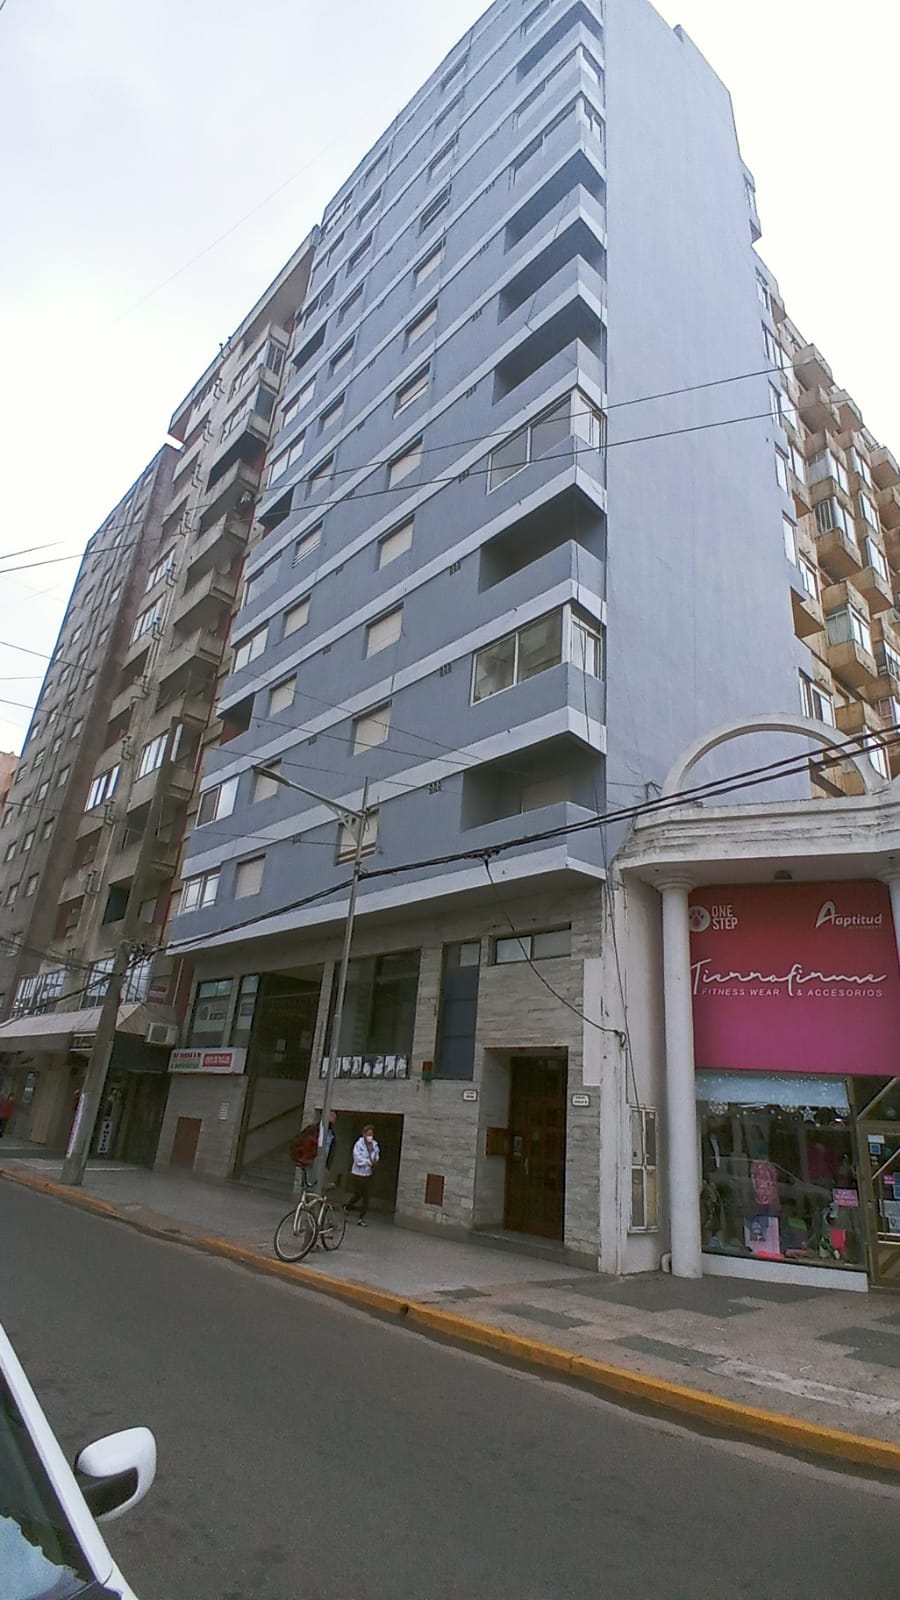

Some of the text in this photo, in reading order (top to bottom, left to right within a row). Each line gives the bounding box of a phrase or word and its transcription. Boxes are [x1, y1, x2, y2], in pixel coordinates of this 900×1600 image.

[711, 904, 733, 917] ONE
[712, 917, 738, 930] STEP
[702, 987, 745, 996] FITNESS
[749, 988, 780, 996] WEAR
[807, 988, 882, 997] ACCESORIOS
